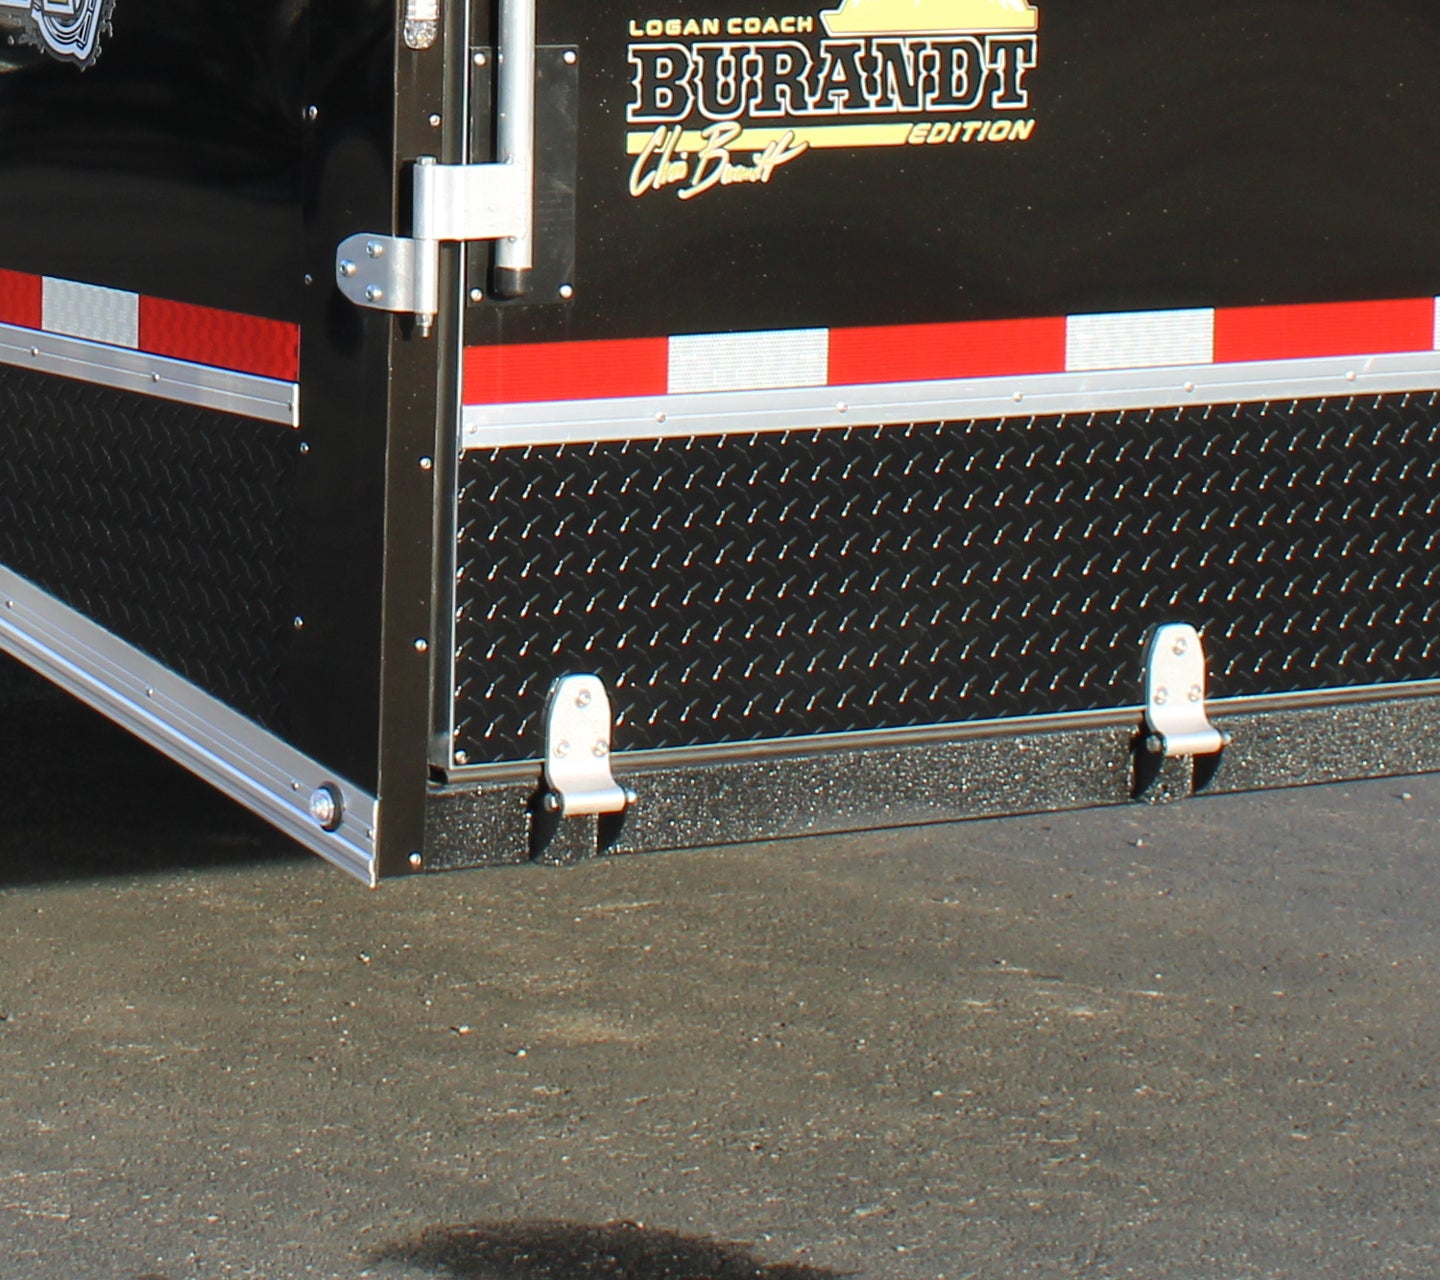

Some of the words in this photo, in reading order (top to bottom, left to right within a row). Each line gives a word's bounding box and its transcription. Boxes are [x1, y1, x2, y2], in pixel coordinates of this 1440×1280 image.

[629, 18, 720, 37] LOGAN
[726, 16, 814, 35] COACH
[626, 34, 1039, 123] BURANDT
[907, 119, 1036, 146] EDITION
